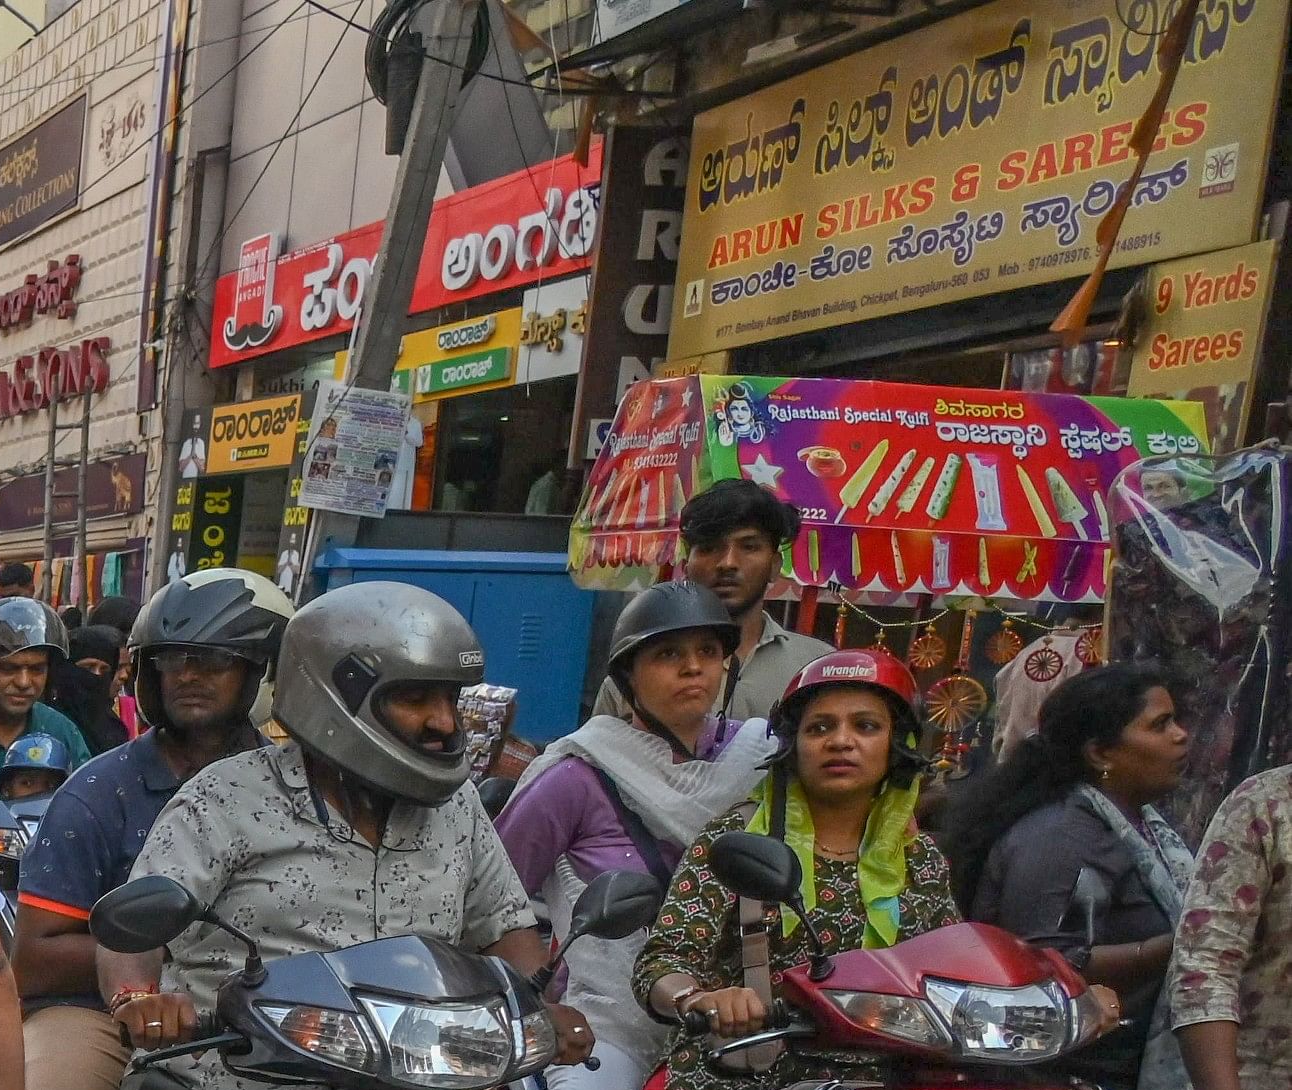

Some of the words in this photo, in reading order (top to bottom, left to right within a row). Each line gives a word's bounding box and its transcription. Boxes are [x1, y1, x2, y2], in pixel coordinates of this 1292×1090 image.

[15, 166, 76, 219] COLLECTIONS
[706, 212, 806, 271] ARUN
[815, 175, 937, 241] SILKS
[950, 163, 981, 205] &
[238, 285, 266, 303] ANGADI
[765, 314, 791, 329] Anand
[791, 306, 821, 323] Bhavan
[971, 267, 991, 283] 053
[997, 263, 1021, 280] Mob
[1155, 275, 1174, 316] 9
[1182, 262, 1260, 310] Yards
[1147, 328, 1245, 372] Sarees
[35, 335, 111, 410] SONS
[212, 398, 299, 443] ರಾಂರಾಜ್
[767, 403, 841, 423] Rajasthani
[843, 407, 893, 425] Special
[895, 408, 930, 430] Kulfi
[933, 398, 1025, 420] ಶಿವಸಾಗರ
[608, 429, 651, 458] Rajasthani
[649, 423, 678, 452] Special
[935, 420, 1048, 460] ರಾಜಸ್ಥಾನಿ
